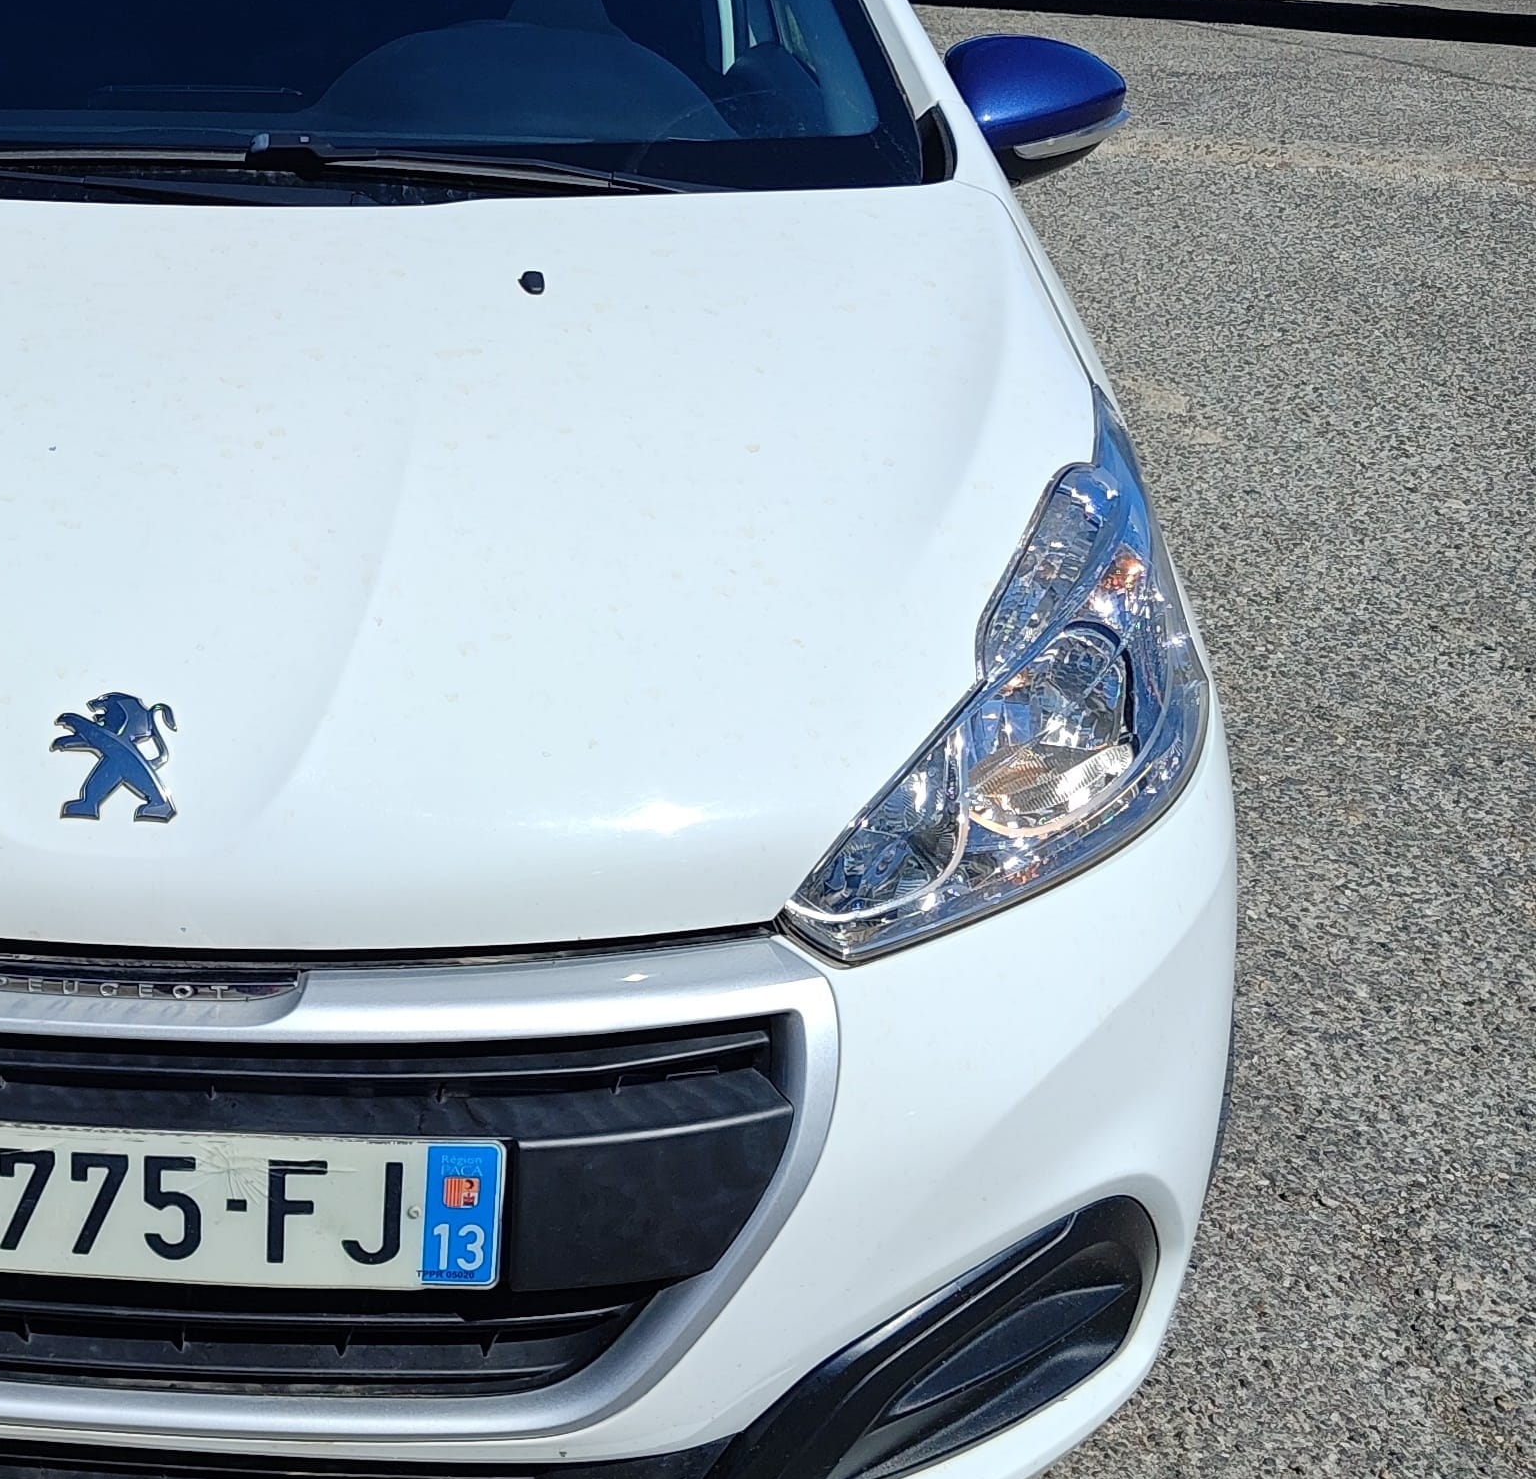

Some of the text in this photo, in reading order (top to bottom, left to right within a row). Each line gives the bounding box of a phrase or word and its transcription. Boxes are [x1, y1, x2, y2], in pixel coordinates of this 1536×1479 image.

[441, 1155, 483, 1167] Région
[440, 1165, 483, 1177] PACA
[433, 1223, 485, 1271] 13
[446, 1270, 475, 1279] 05020
